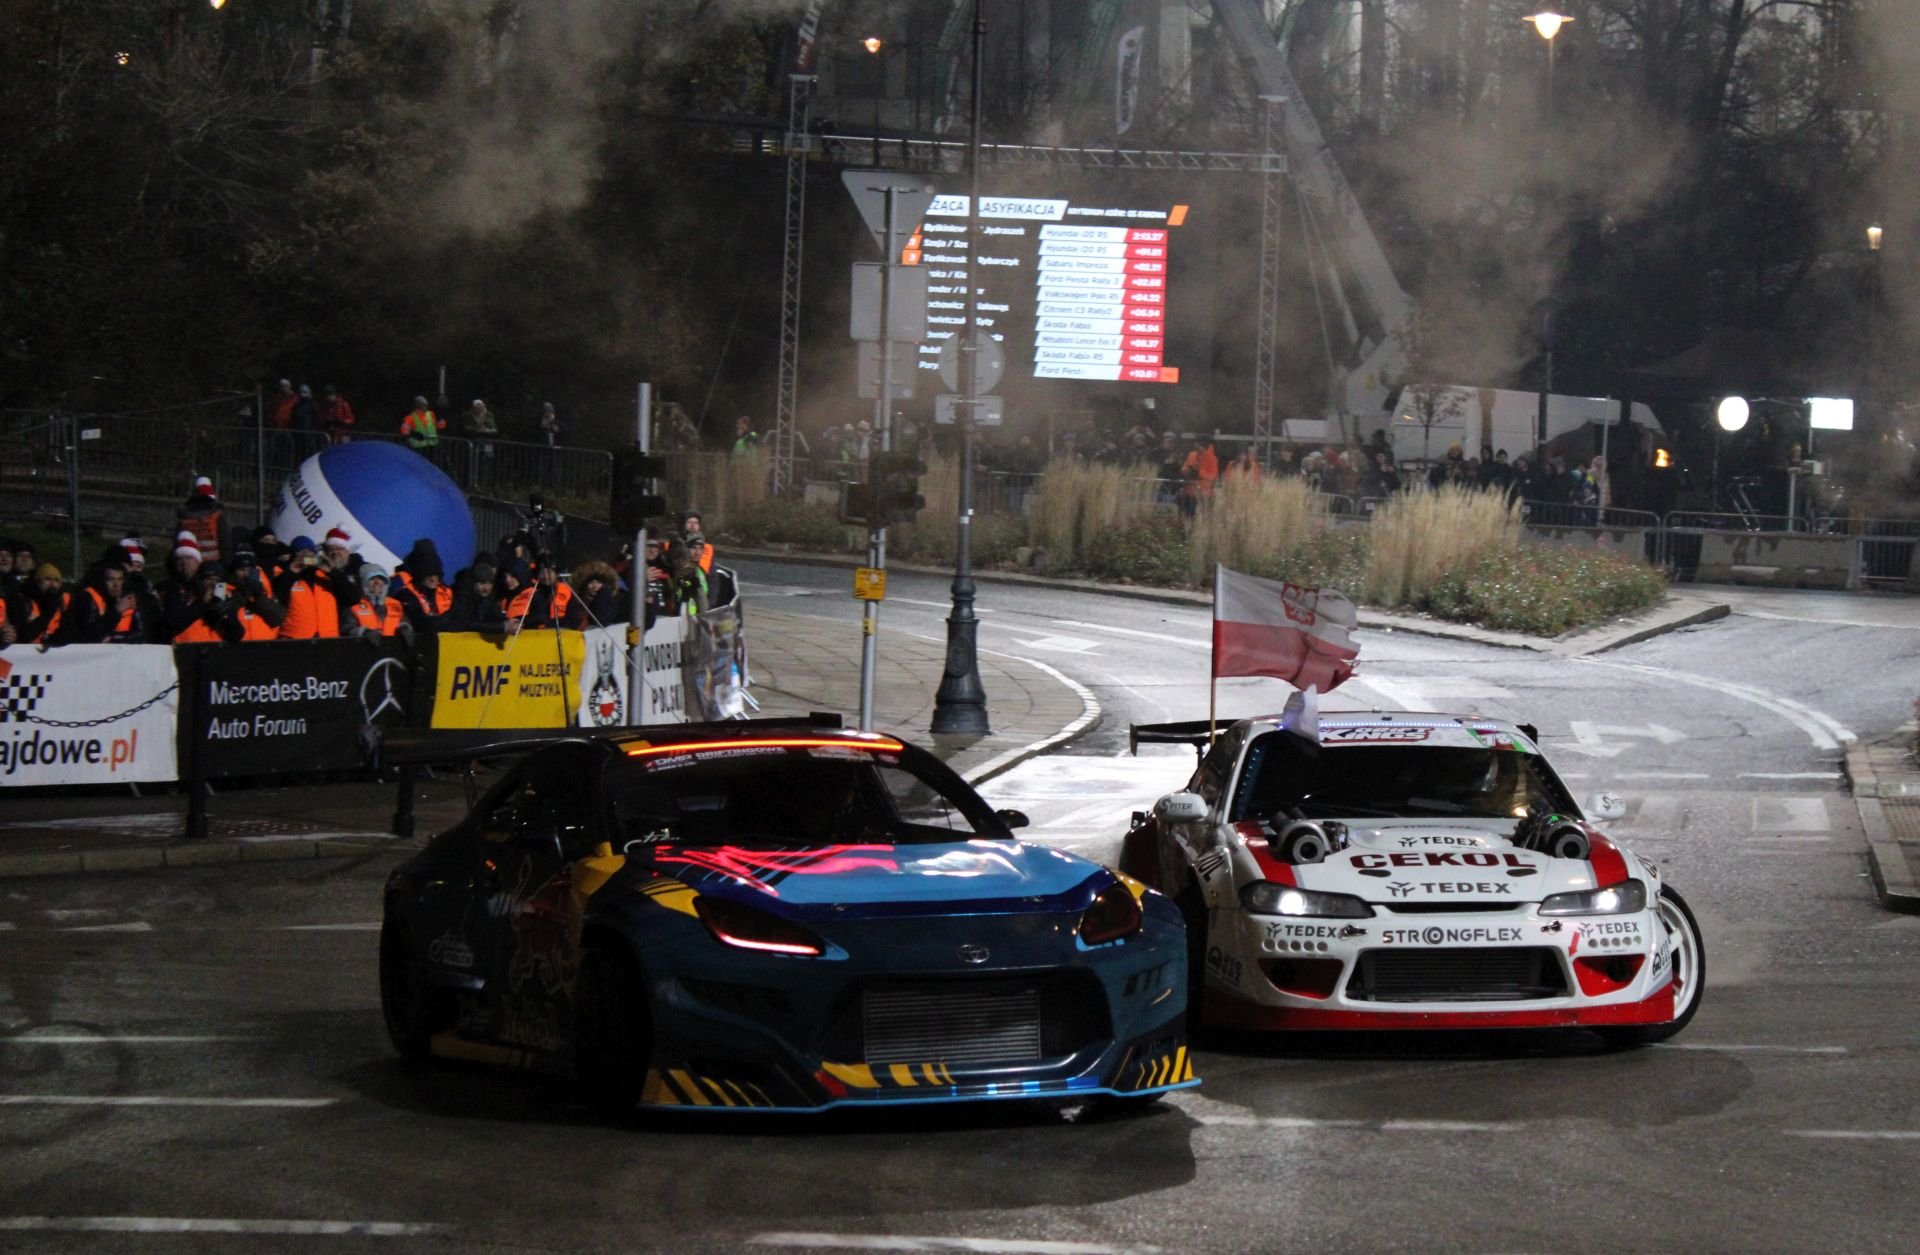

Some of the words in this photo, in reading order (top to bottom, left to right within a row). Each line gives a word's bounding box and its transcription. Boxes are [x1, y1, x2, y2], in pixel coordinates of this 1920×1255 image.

[980, 201, 1055, 215] ASYFIKACJA
[1062, 366, 1081, 375] Fiest
[450, 664, 511, 700] RMF
[210, 676, 349, 705] Mercedes-Benz
[519, 683, 561, 698] MUZYKA
[207, 717, 250, 740] Auto
[254, 715, 307, 737] Forum
[1160, 797, 1193, 811] SPITER
[1421, 836, 1479, 847] TEDEX
[1349, 852, 1536, 869] CEKOL
[1420, 882, 1511, 894] TEDEX
[1285, 925, 1337, 938] TEDEX
[1596, 921, 1640, 935] TEDEX
[1382, 926, 1523, 945] STRONGFLEX
